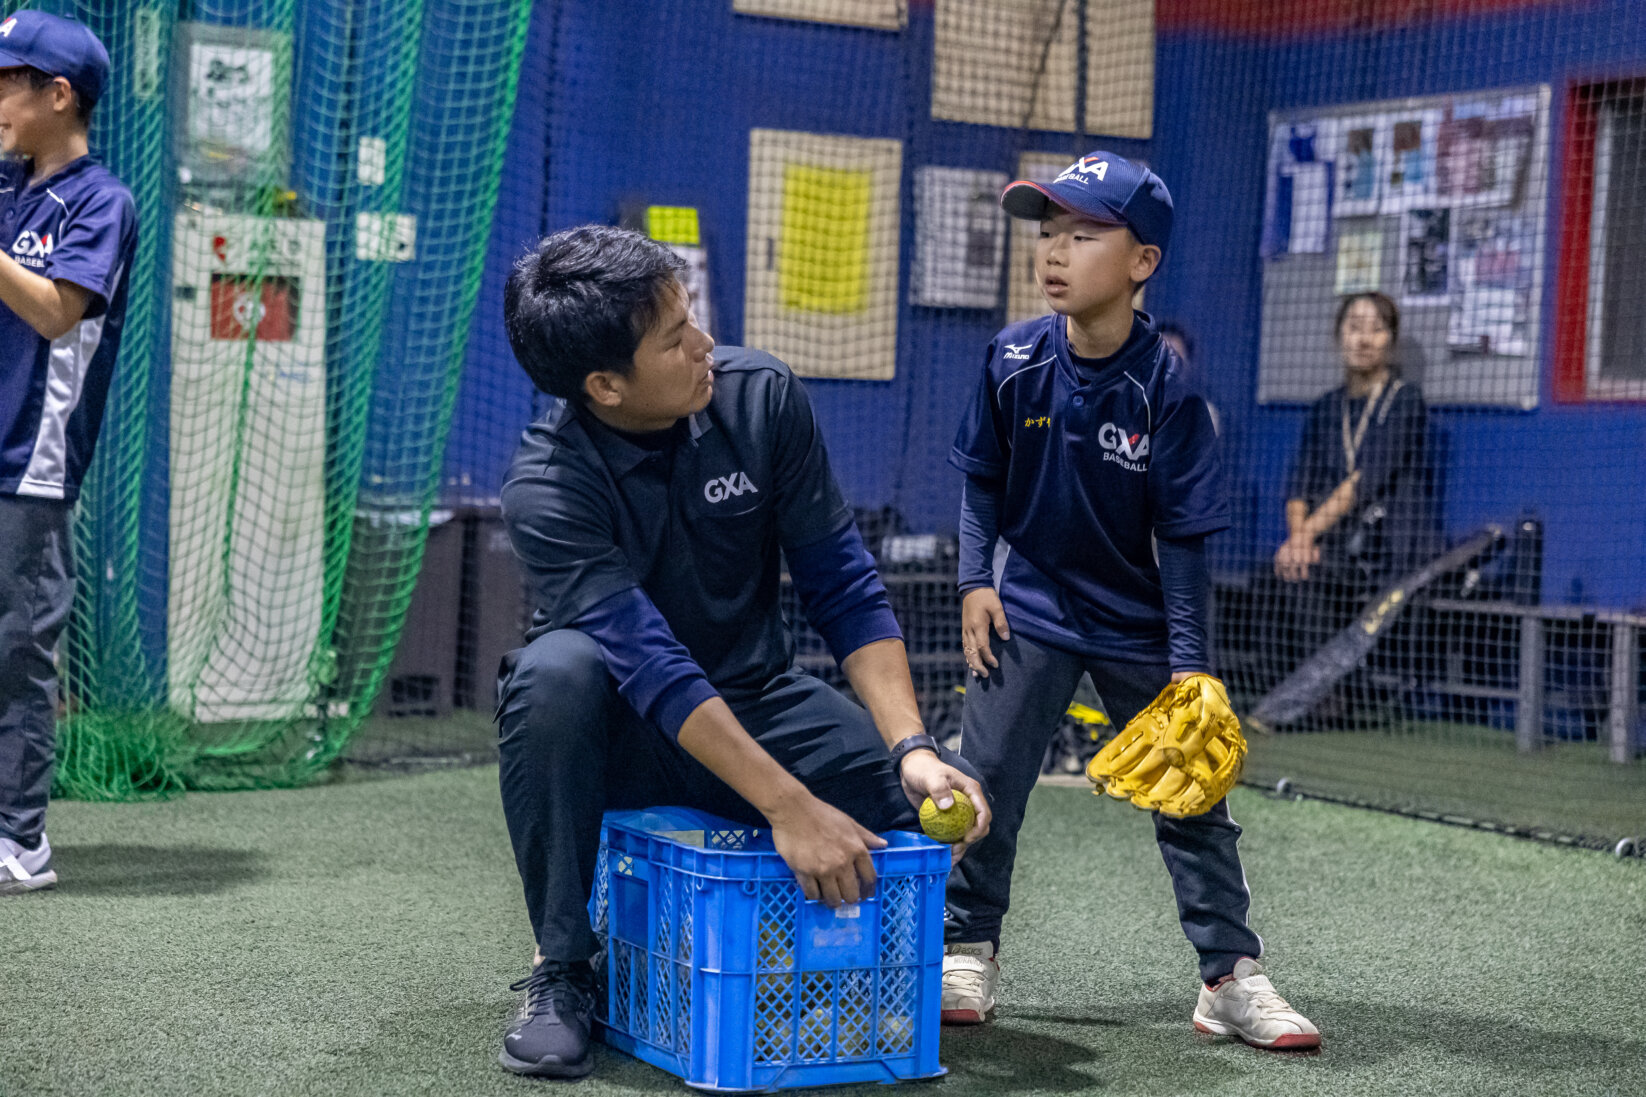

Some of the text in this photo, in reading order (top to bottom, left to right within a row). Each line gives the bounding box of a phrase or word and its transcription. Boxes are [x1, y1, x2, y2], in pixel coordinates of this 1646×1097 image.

[1098, 422, 1150, 461] GXA
[1103, 451, 1149, 472] BASEBALL
[703, 471, 759, 504] GXA
